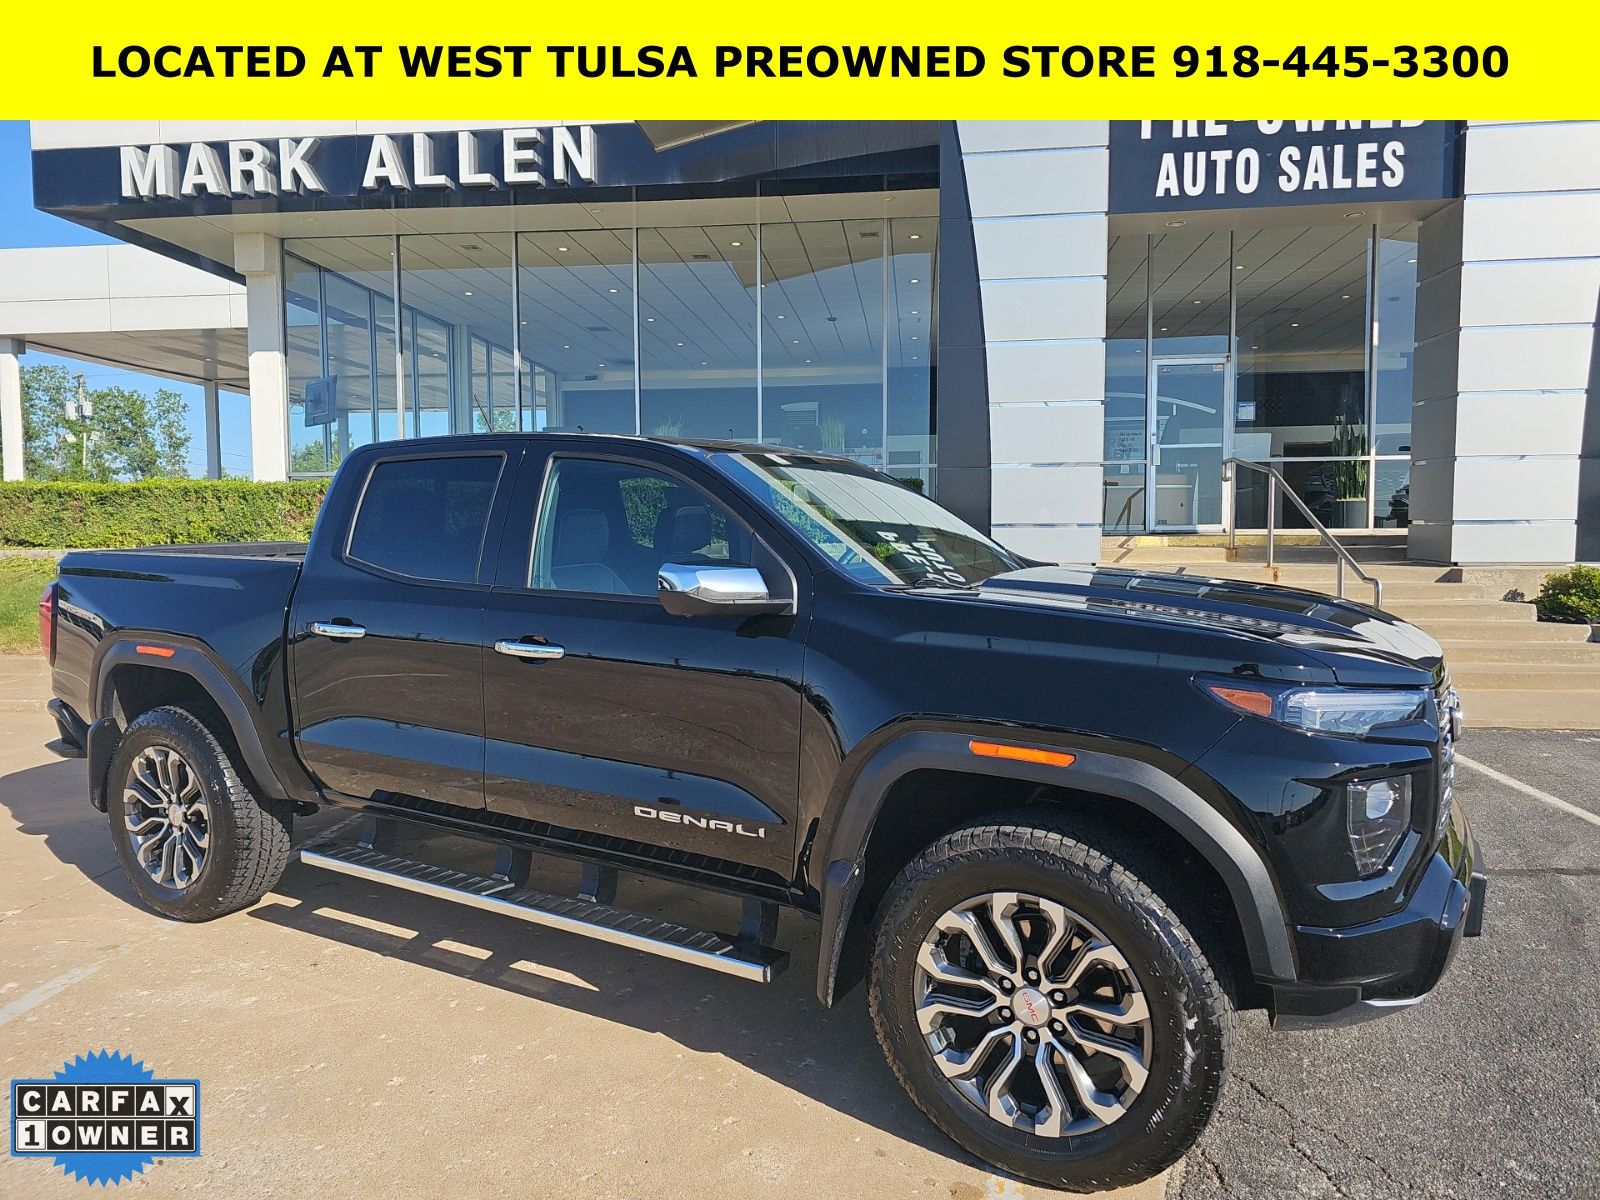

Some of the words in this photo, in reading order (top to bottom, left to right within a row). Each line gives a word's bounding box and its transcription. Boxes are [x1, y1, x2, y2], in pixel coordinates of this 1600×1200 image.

[120, 138, 325, 199] MARK
[362, 126, 597, 190] ALLEN
[1155, 147, 1260, 197] AUTO
[1278, 140, 1405, 193] SALES
[633, 805, 766, 839] DENALI
[1022, 991, 1040, 1024] GMC
